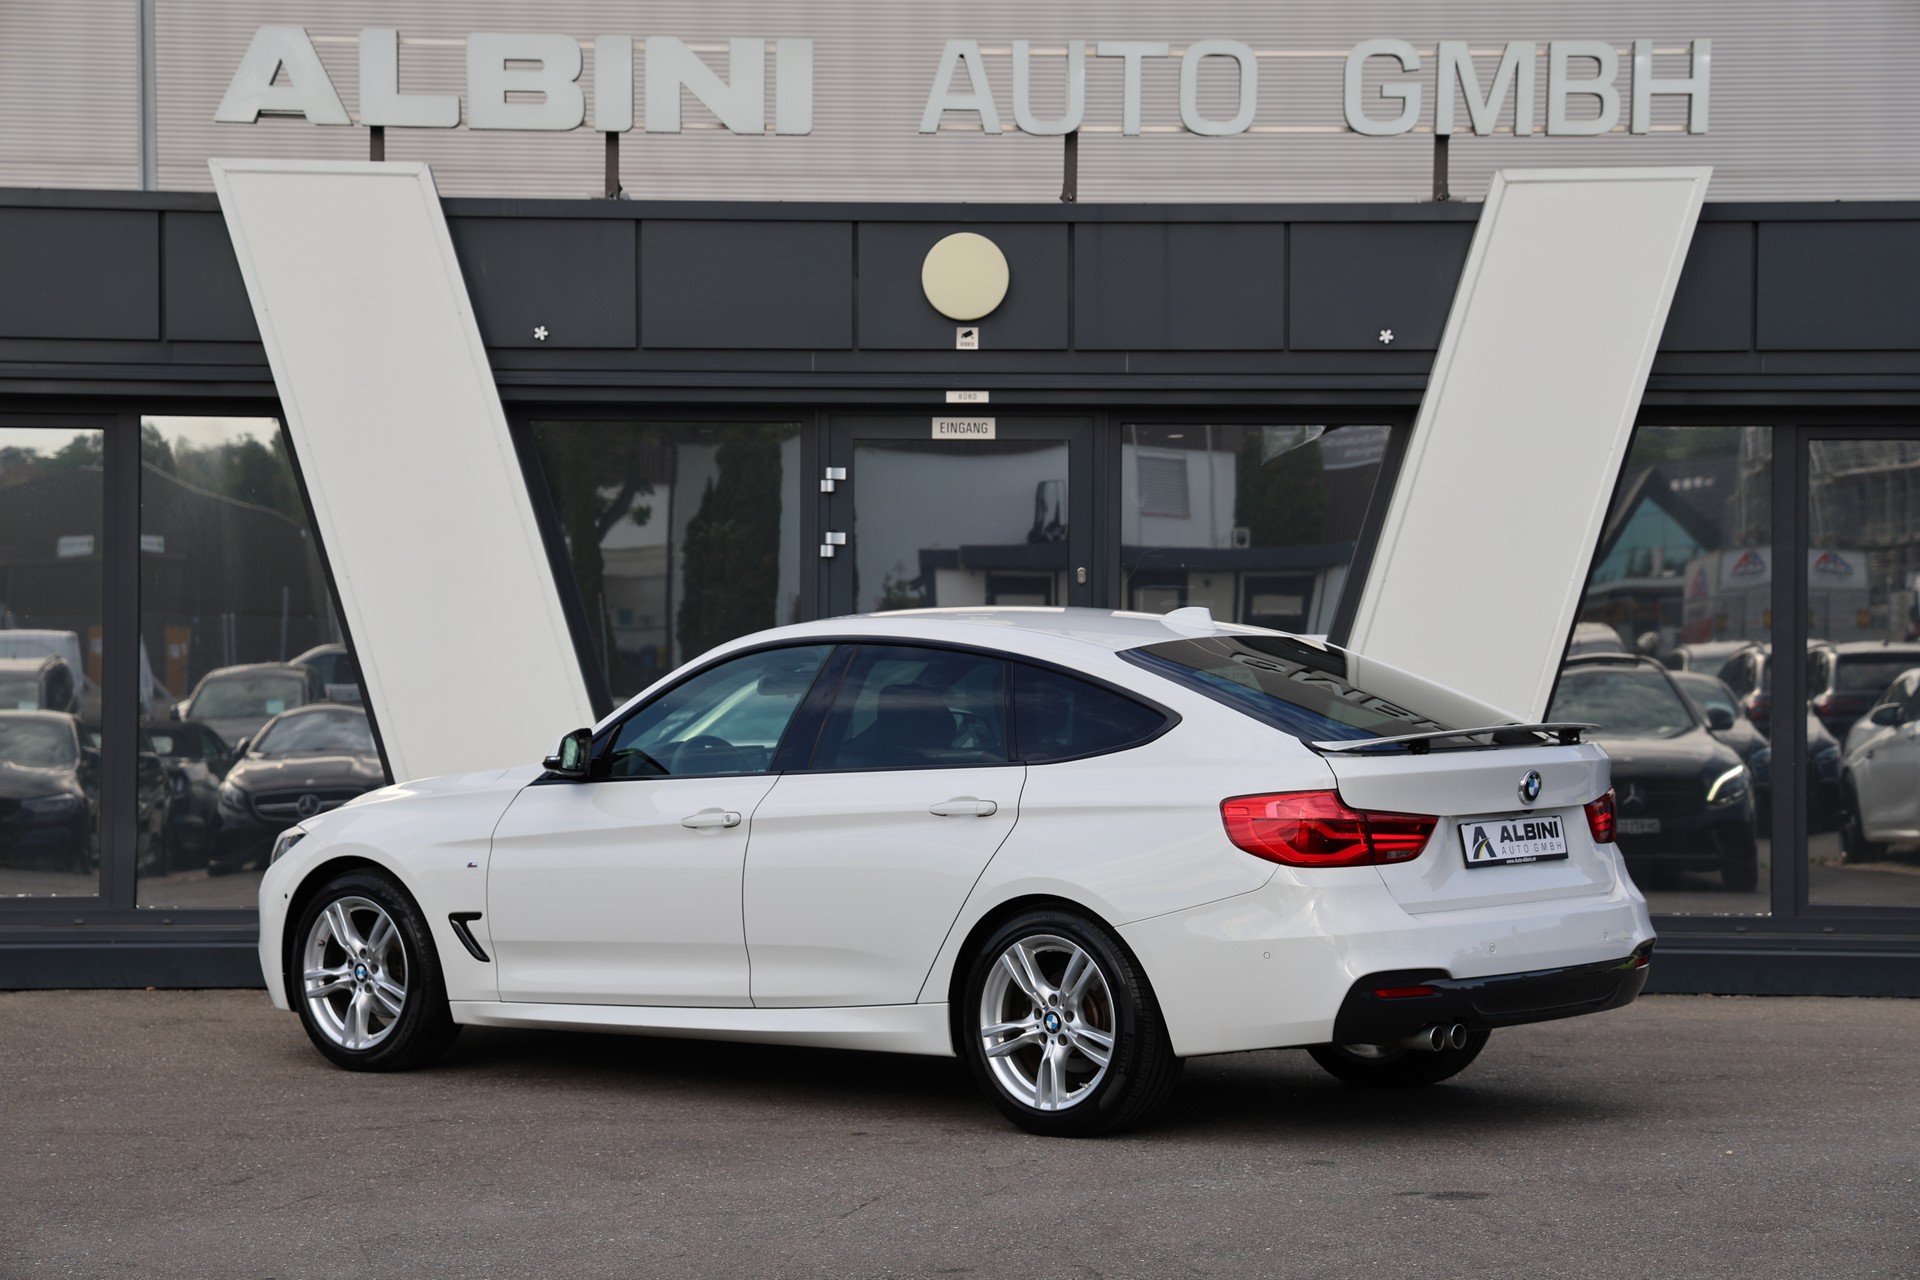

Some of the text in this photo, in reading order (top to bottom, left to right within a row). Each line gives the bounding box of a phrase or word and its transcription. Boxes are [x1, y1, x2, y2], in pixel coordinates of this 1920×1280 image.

[214, 25, 1711, 137] ALBINI AUTO GMBH
[940, 422, 988, 434] EINGANG
[1500, 821, 1559, 843] ALBINI
[1502, 841, 1562, 855] AUTO GMBH
